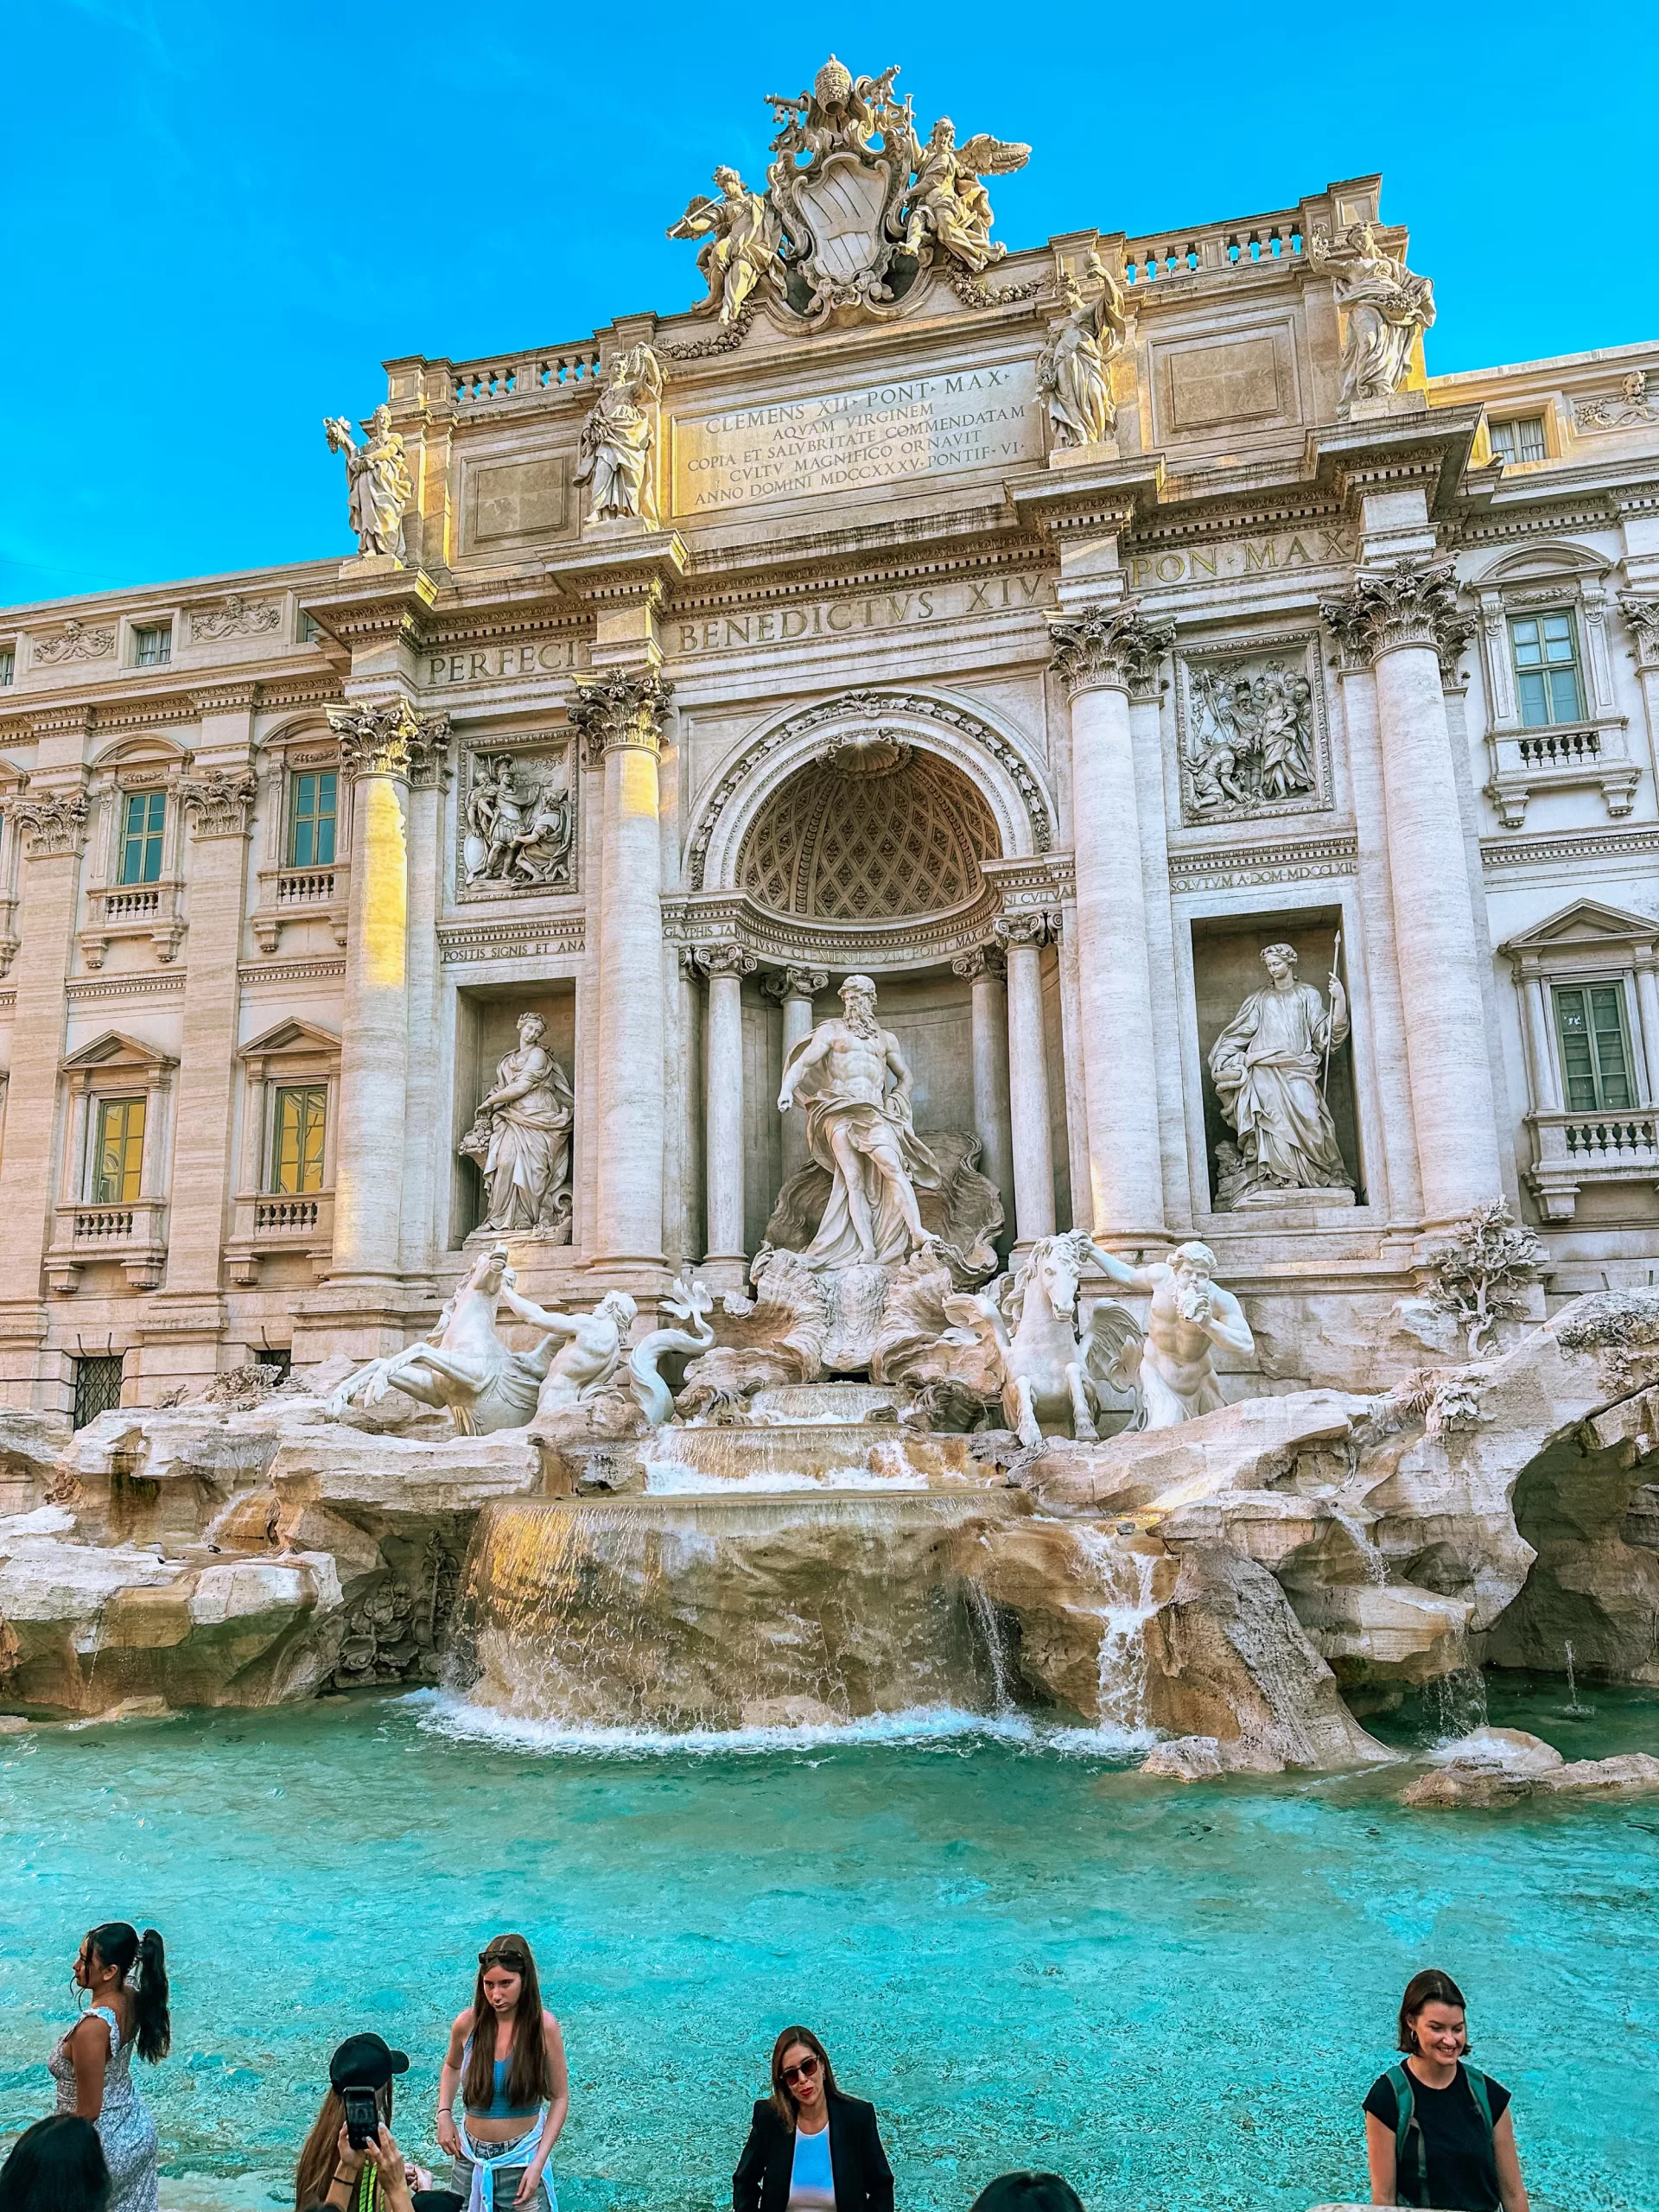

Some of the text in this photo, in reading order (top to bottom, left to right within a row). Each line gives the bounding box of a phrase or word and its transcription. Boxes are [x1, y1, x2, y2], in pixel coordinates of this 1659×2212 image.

[706, 404, 804, 434] CLEMENS
[772, 404, 934, 441] AQVAM VIRGINEM
[688, 405, 1025, 472] COPIA ET SALVBRITATE COMMENDATAM
[730, 430, 982, 482] CVLTV MAGNIFICO ORNAVIT
[695, 487, 743, 505] ANNO
[750, 476, 812, 497] DOMINI
[678, 591, 933, 652] BENEDICTVS
[1170, 874, 1233, 892] SOLVTVM
[443, 949, 486, 962] POSITIS
[492, 945, 528, 957] SIGNIS
[536, 943, 550, 954] ET
